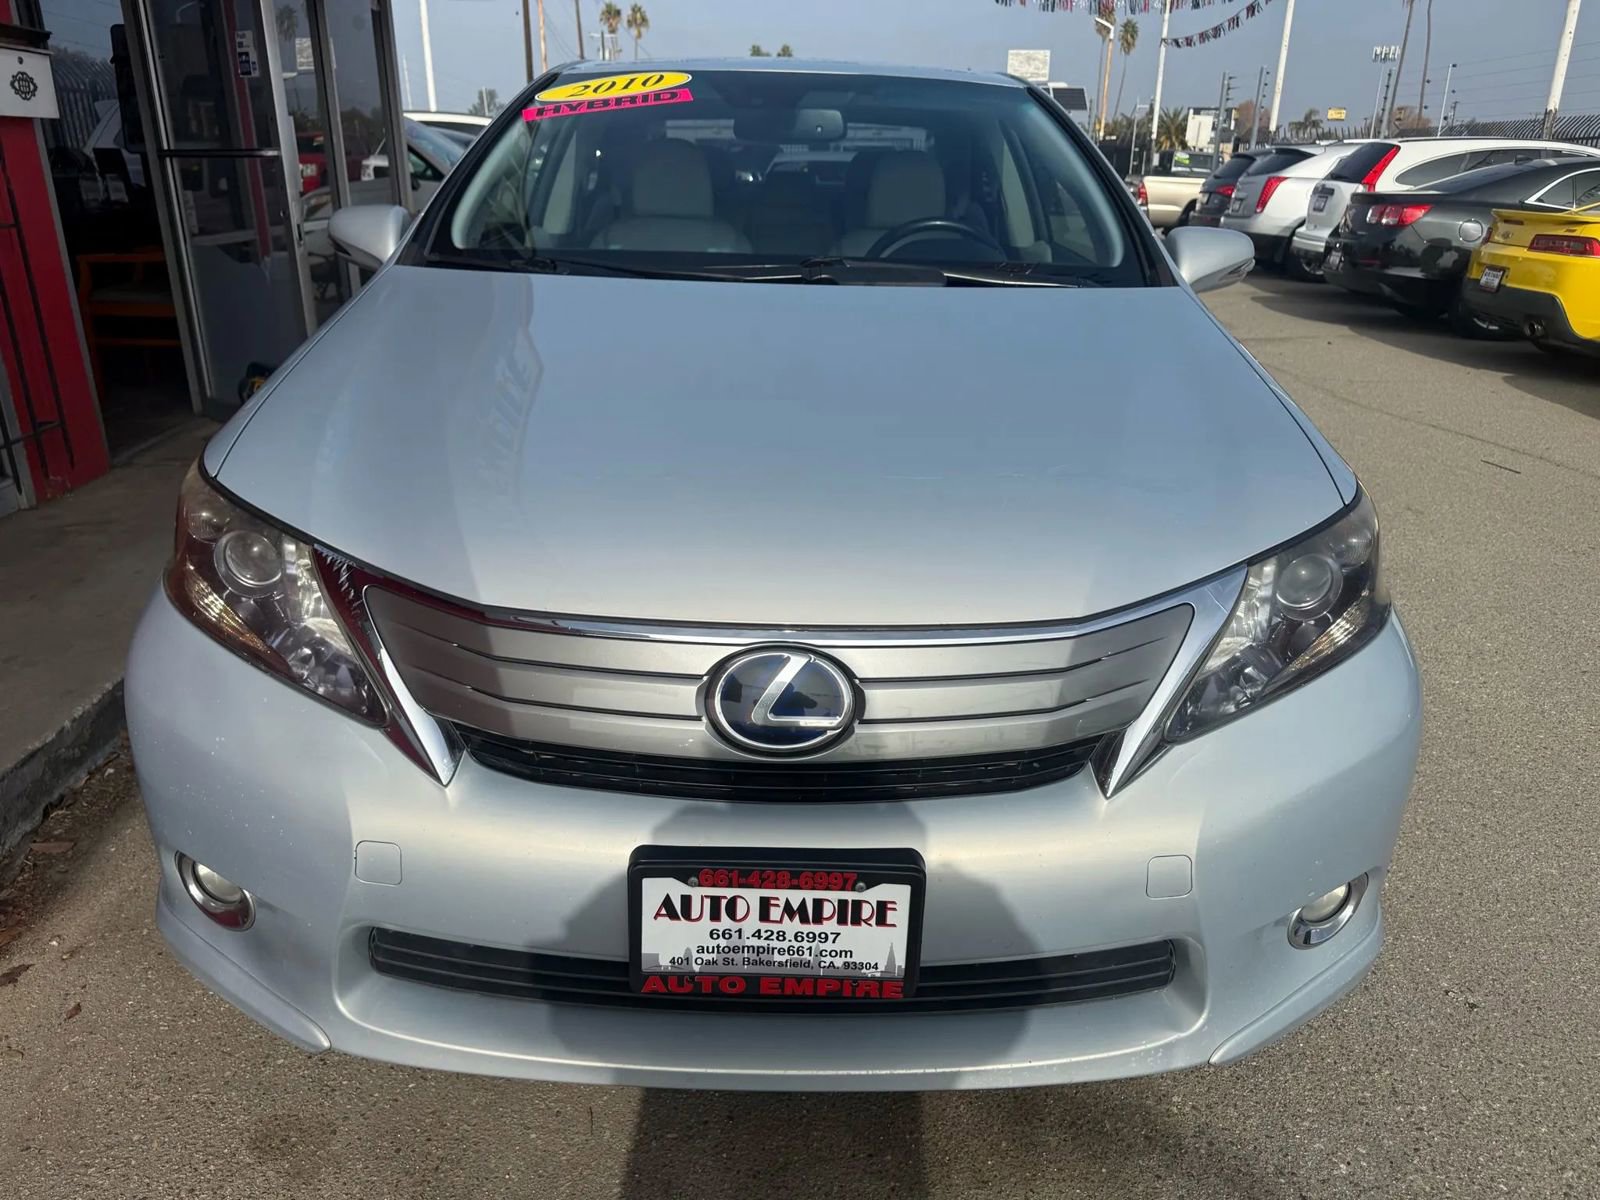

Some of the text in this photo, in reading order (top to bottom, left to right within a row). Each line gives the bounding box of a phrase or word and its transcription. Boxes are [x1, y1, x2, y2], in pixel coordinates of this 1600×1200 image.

[565, 74, 665, 98] 2010
[535, 91, 681, 117] HYBRID
[698, 868, 857, 891] 661-428-6997
[653, 893, 898, 928] AUTO EMPIRE
[708, 928, 841, 944] 661.428.6997
[696, 943, 853, 959] autoempire661.com
[669, 956, 879, 971] 401 Oak St. Bakersfield, CA. 93304
[641, 975, 904, 999] AUTO EMPIRE
